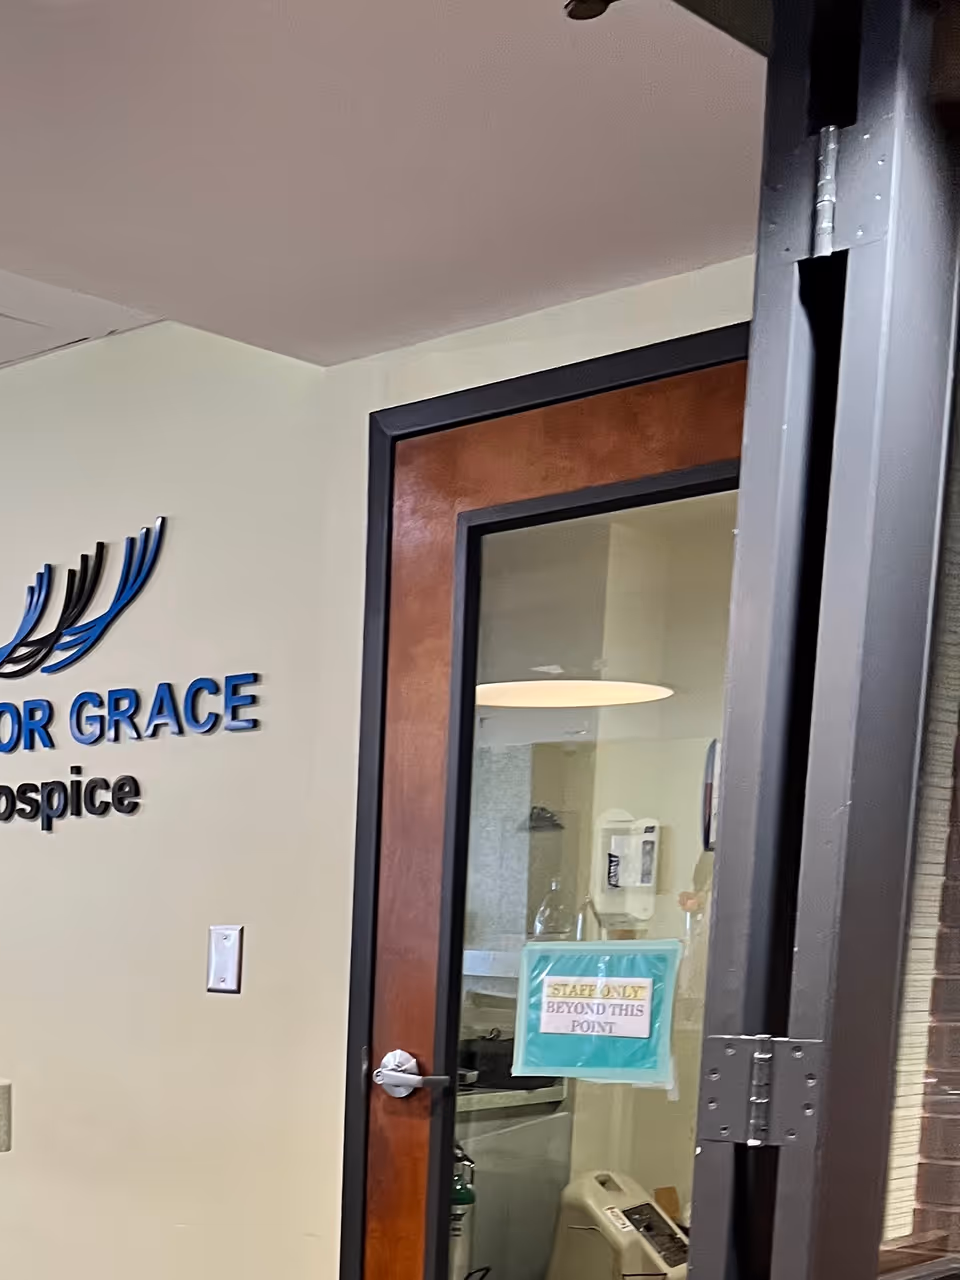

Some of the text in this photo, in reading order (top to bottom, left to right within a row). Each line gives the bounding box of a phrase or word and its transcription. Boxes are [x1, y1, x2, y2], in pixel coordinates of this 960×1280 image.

[70, 672, 260, 746] GRACE
[546, 1000, 645, 1017] BEYOND THIS
[570, 1019, 617, 1034] POINT
